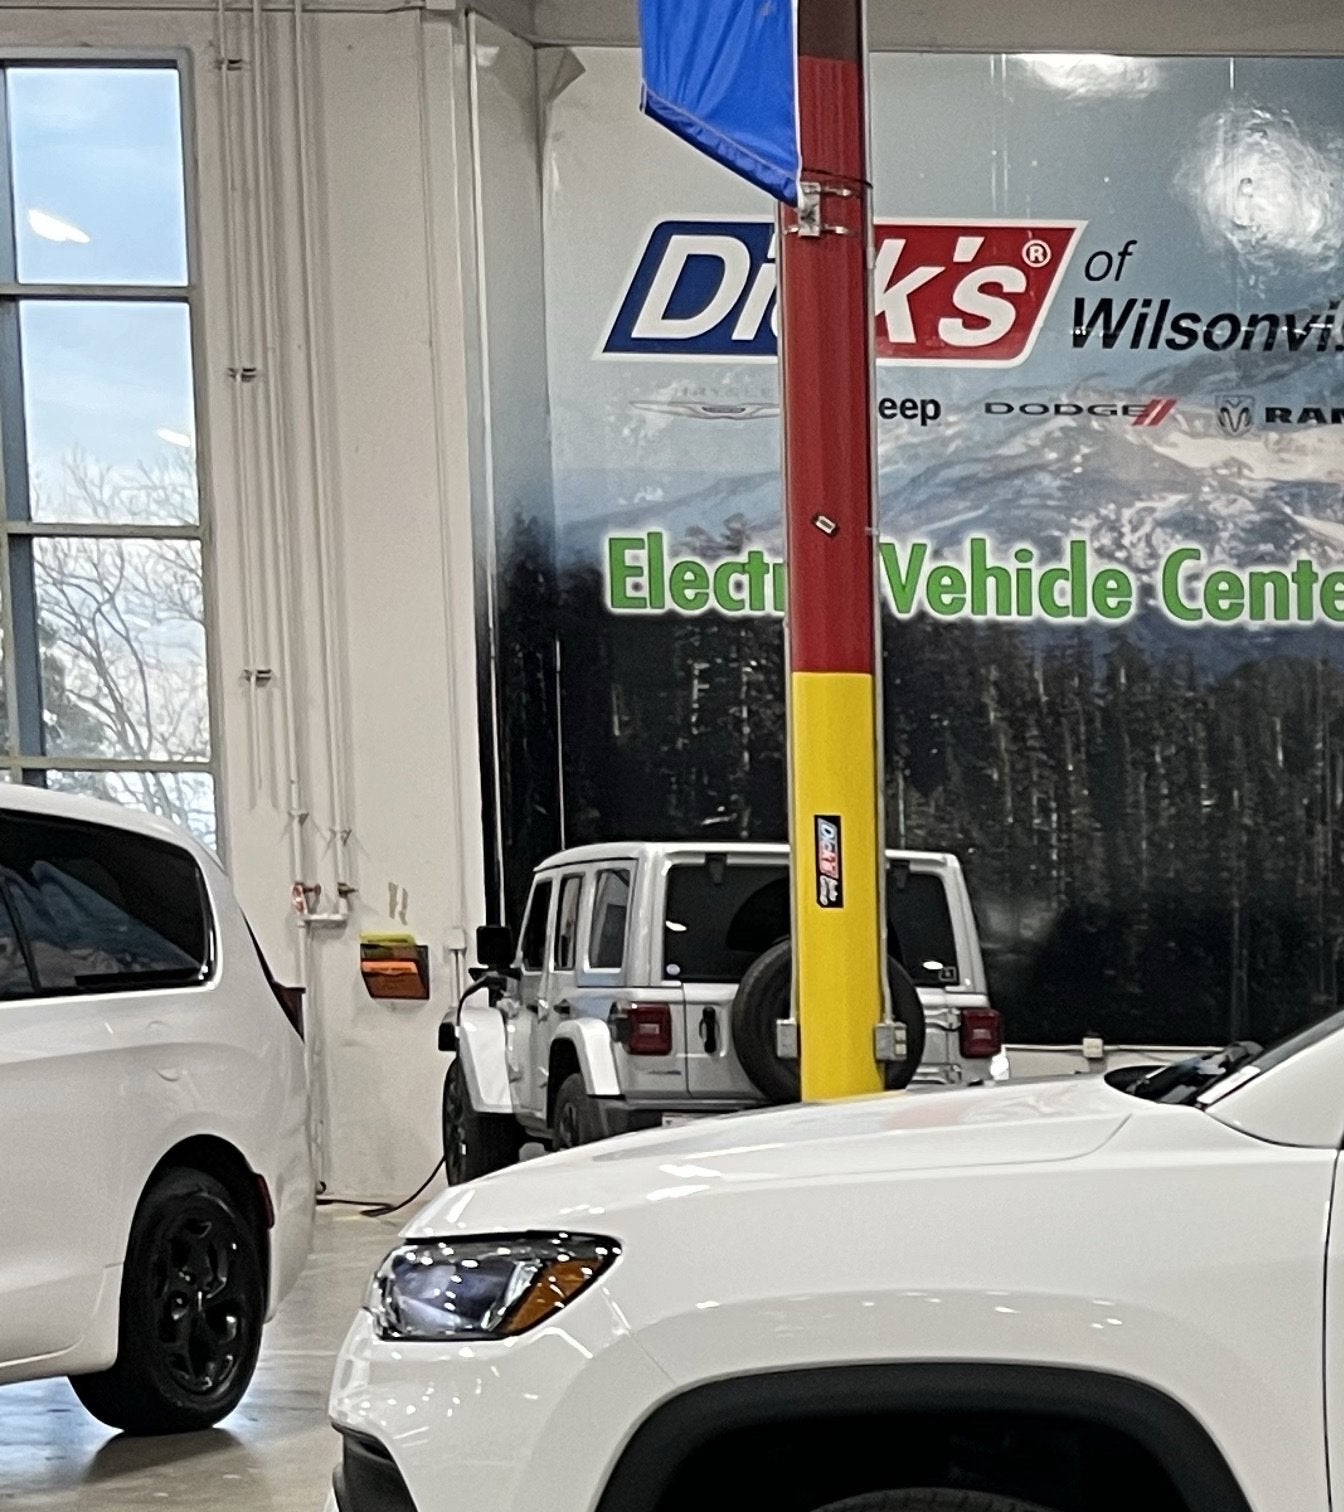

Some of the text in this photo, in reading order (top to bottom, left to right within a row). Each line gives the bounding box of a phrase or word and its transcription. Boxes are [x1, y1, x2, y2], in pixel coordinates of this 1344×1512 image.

[631, 234, 1027, 347] Dik's
[1084, 240, 1138, 282] of
[878, 397, 942, 426] eep
[984, 402, 1147, 417] DODGE
[609, 532, 784, 612] Elect
[879, 538, 1133, 618] Vehicle
